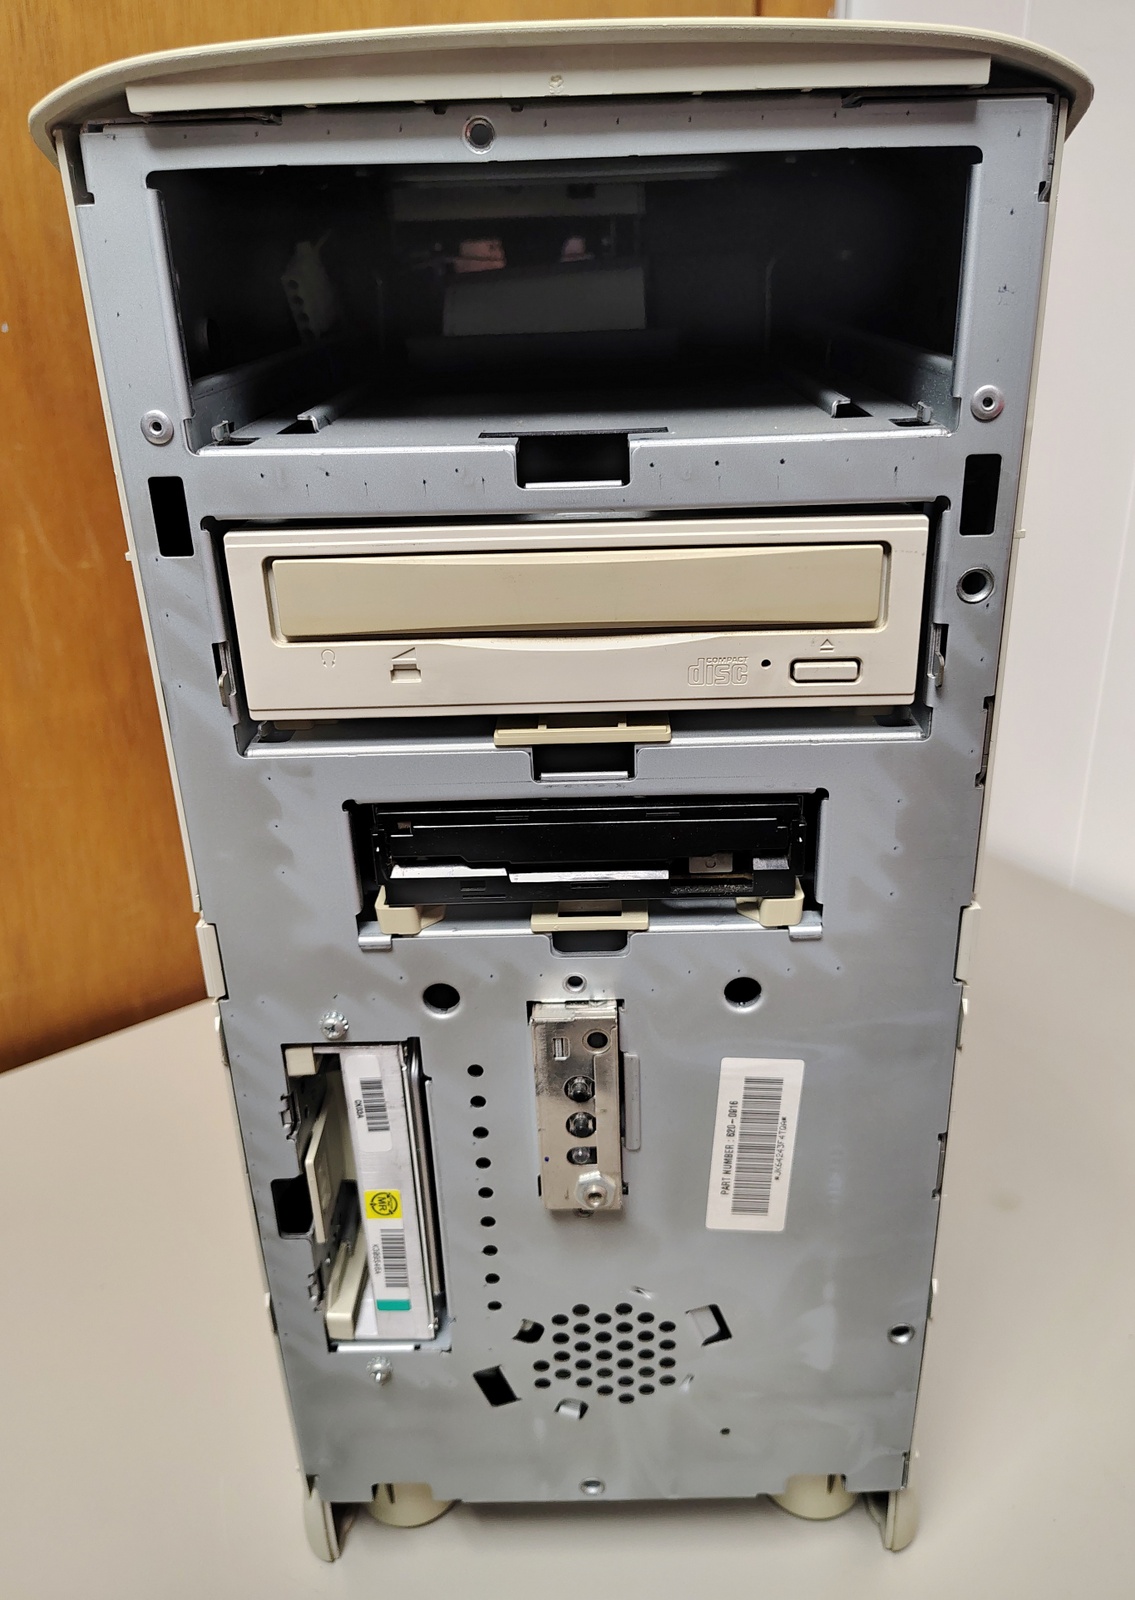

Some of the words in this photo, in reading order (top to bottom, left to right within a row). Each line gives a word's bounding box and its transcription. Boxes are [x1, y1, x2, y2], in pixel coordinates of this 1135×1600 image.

[706, 656, 748, 664] COMPACT
[687, 657, 748, 687] disc
[723, 1144, 735, 1175] NUMBER
[720, 1176, 731, 1195] PART
[377, 1196, 388, 1211] MR
